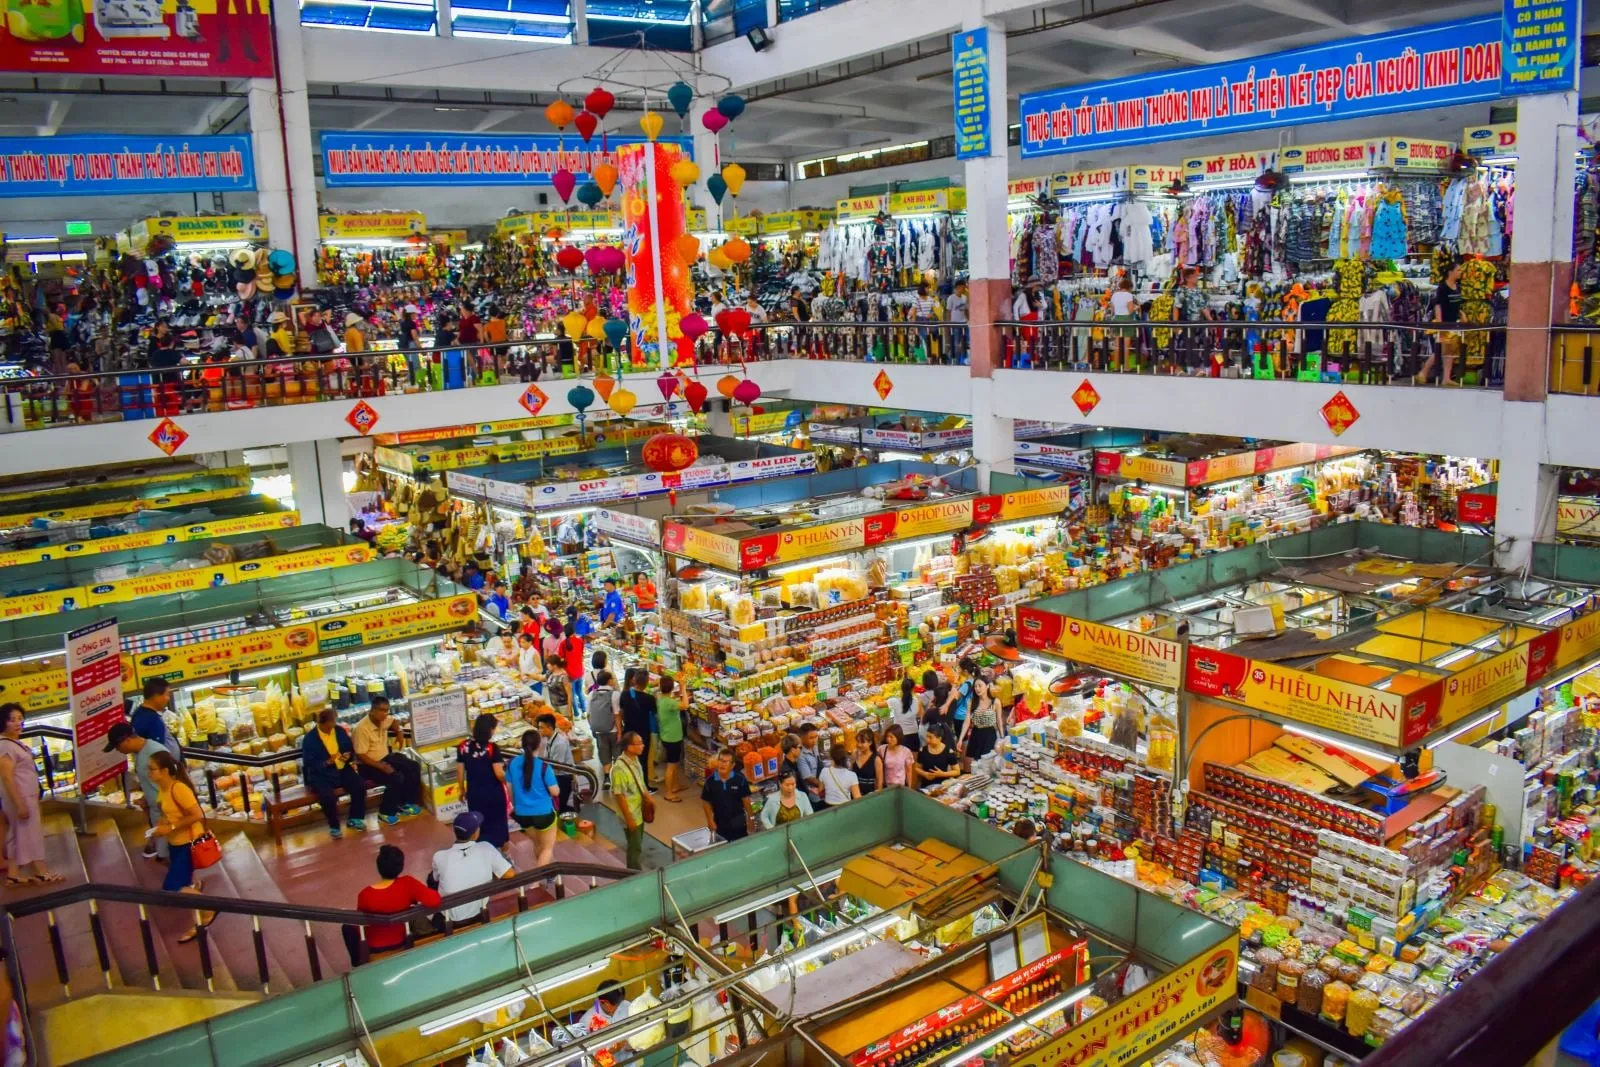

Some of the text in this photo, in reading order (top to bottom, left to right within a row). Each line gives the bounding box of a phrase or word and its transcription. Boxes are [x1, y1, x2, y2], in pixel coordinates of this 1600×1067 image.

[1026, 109, 1050, 148] THỰC
[1051, 103, 1074, 145] HIỆN
[1074, 96, 1093, 136] TỐT
[1094, 98, 1115, 134] VĂN
[1116, 98, 1143, 130] MINH
[1146, 89, 1188, 126] THƯƠNG
[1191, 87, 1213, 127] MẠI
[1214, 77, 1229, 118] LÀ
[1231, 66, 1255, 115] THỂ
[1257, 68, 1285, 118] HIỆN
[1289, 63, 1313, 108] NÉT
[1315, 68, 1342, 111] ĐẸP
[1344, 52, 1373, 100] CỦA
[1376, 47, 1420, 96] NGƯỜI
[1423, 47, 1459, 89] KINH
[72, 154, 87, 181] DO
[88, 153, 113, 180] UBND
[113, 146, 145, 180] THÀNH
[144, 143, 164, 179] PHỐ
[164, 146, 179, 179] ĐÀ
[178, 142, 201, 178] NẴNG
[203, 152, 219, 178] GHI
[220, 145, 243, 183] NHẬN
[328, 150, 346, 174] MUA
[346, 144, 363, 174] BÁN
[363, 144, 384, 174] HÀNG
[1229, 154, 1256, 171] HÒA
[1343, 145, 1364, 161] SEN
[910, 501, 970, 523] SHOP LOAN
[134, 583, 173, 596] THANH
[1083, 624, 1122, 650] NAM
[1254, 670, 1264, 681] 35
[1326, 687, 1398, 722] NHÂN
[1179, 1009, 1196, 1025] CÁC
